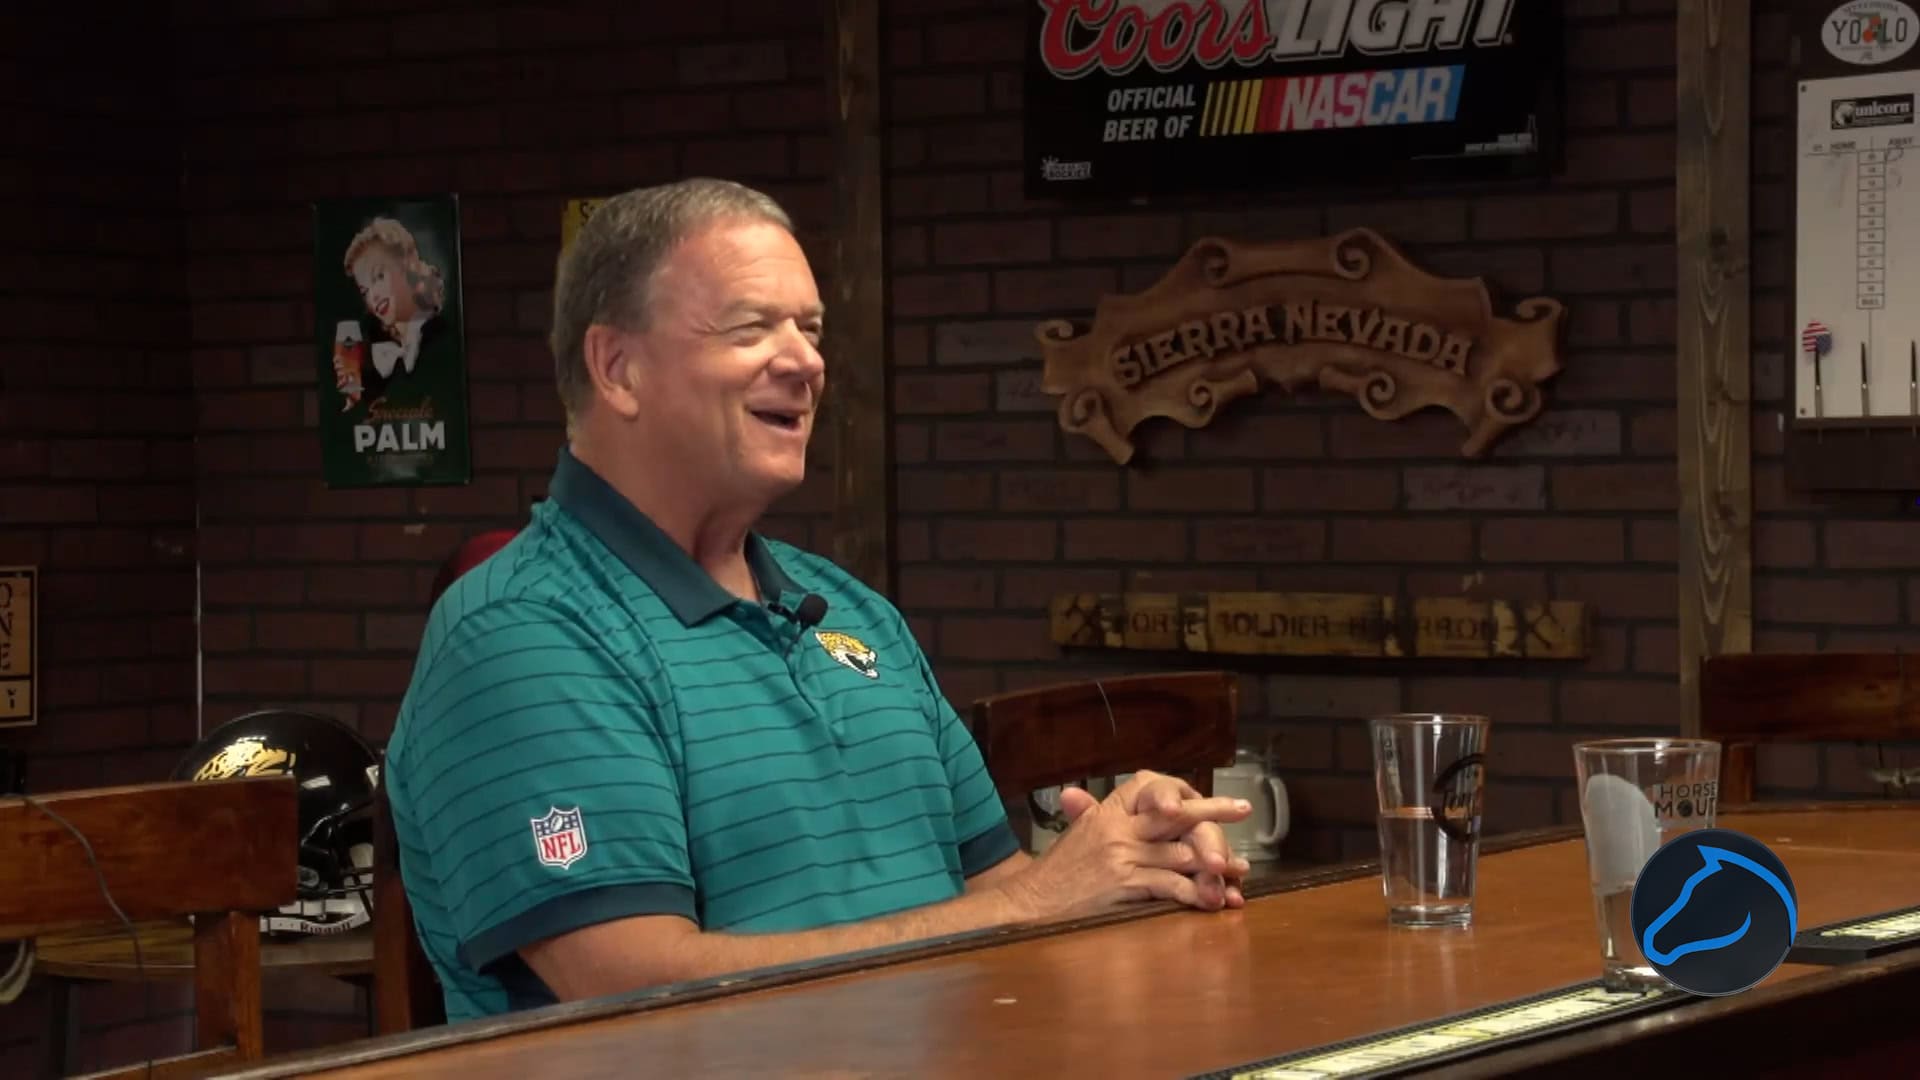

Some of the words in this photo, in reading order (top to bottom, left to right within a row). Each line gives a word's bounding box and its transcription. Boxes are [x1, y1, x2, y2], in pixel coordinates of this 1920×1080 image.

[1039, 0, 1275, 79] Coors
[1272, 0, 1512, 60] LIGHT
[1106, 83, 1197, 113] OFFICIAL
[1278, 67, 1453, 131] NASCAR
[1855, 101, 1911, 117] unicorn
[1103, 116, 1158, 143] BEER
[1162, 113, 1192, 140] OF
[1114, 304, 1275, 386] SIERRA
[1283, 299, 1473, 376] NEVADA
[353, 420, 447, 453] PALM
[1660, 780, 1718, 799] HORSE
[541, 831, 582, 860] NFL
